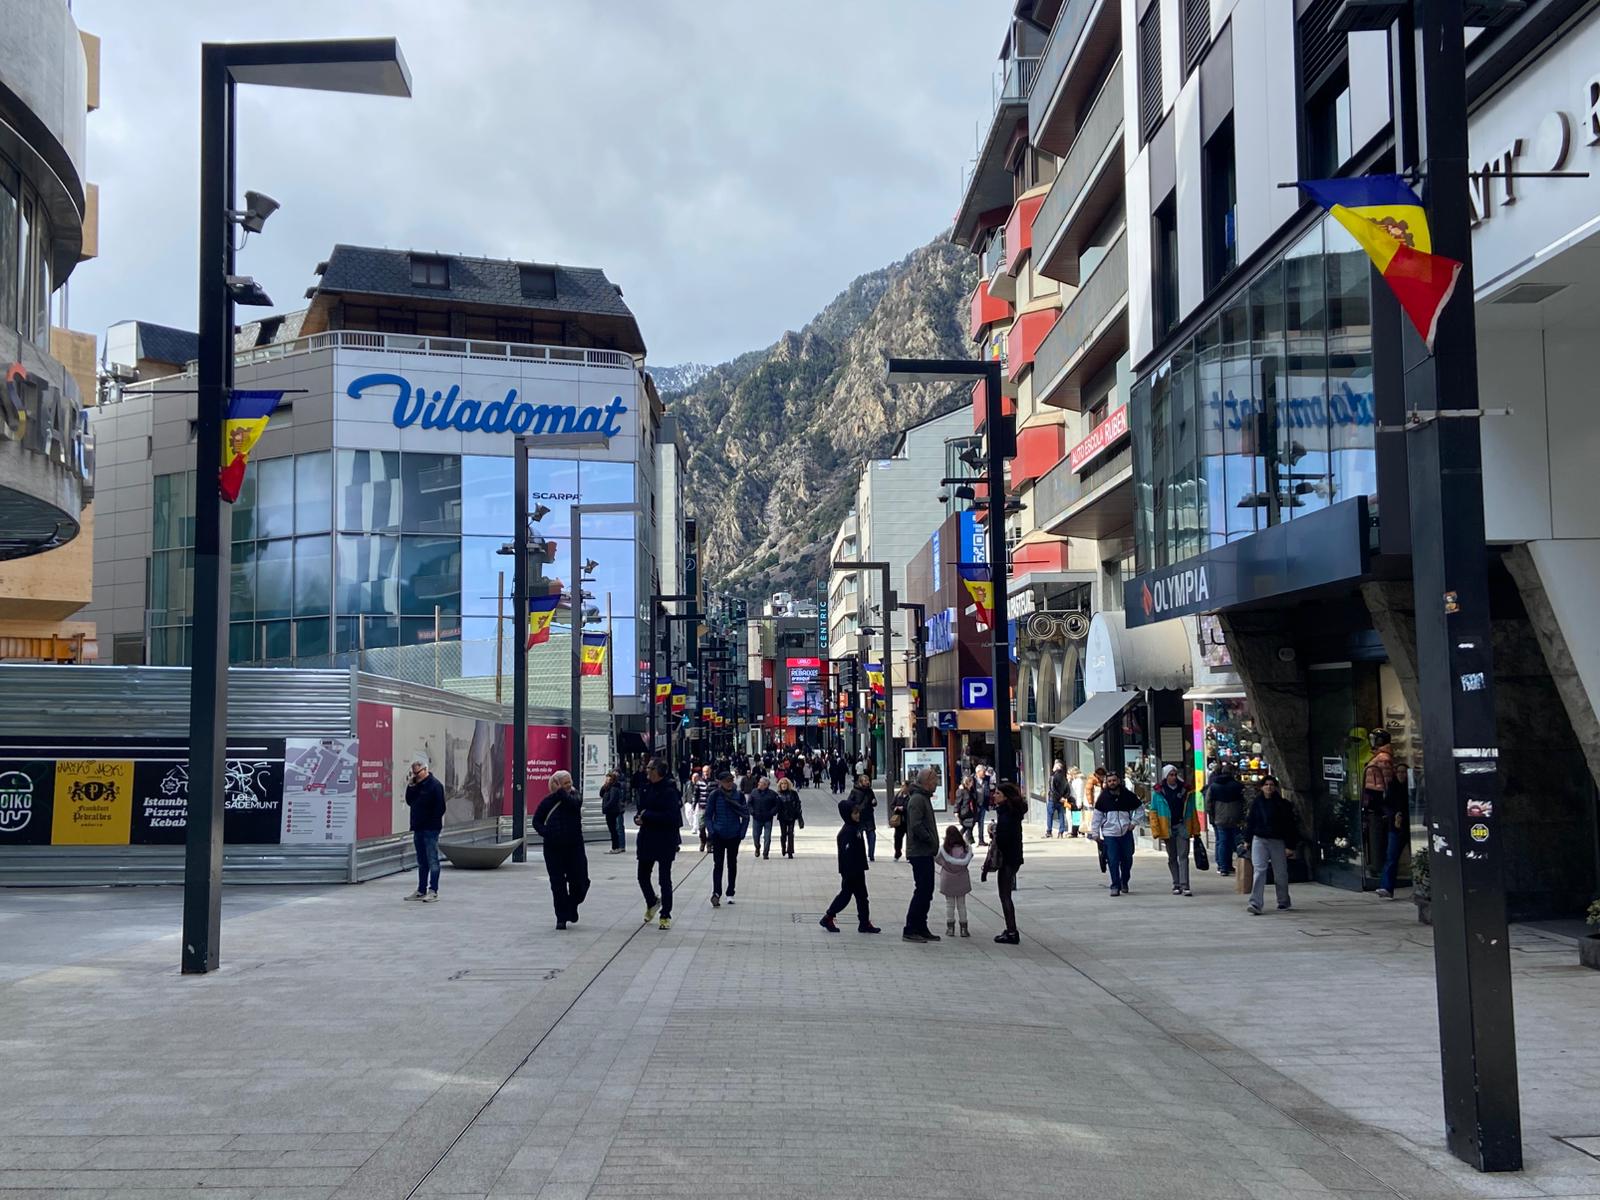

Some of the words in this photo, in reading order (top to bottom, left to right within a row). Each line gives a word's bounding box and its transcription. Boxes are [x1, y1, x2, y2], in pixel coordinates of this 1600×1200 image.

[347, 373, 628, 437] Viladomat
[1104, 407, 1127, 445] RUBEN
[532, 492, 580, 501] SCARPA
[1154, 566, 1209, 613] OLYMPIA
[969, 682, 988, 704] P
[150, 818, 187, 827] Kebab
